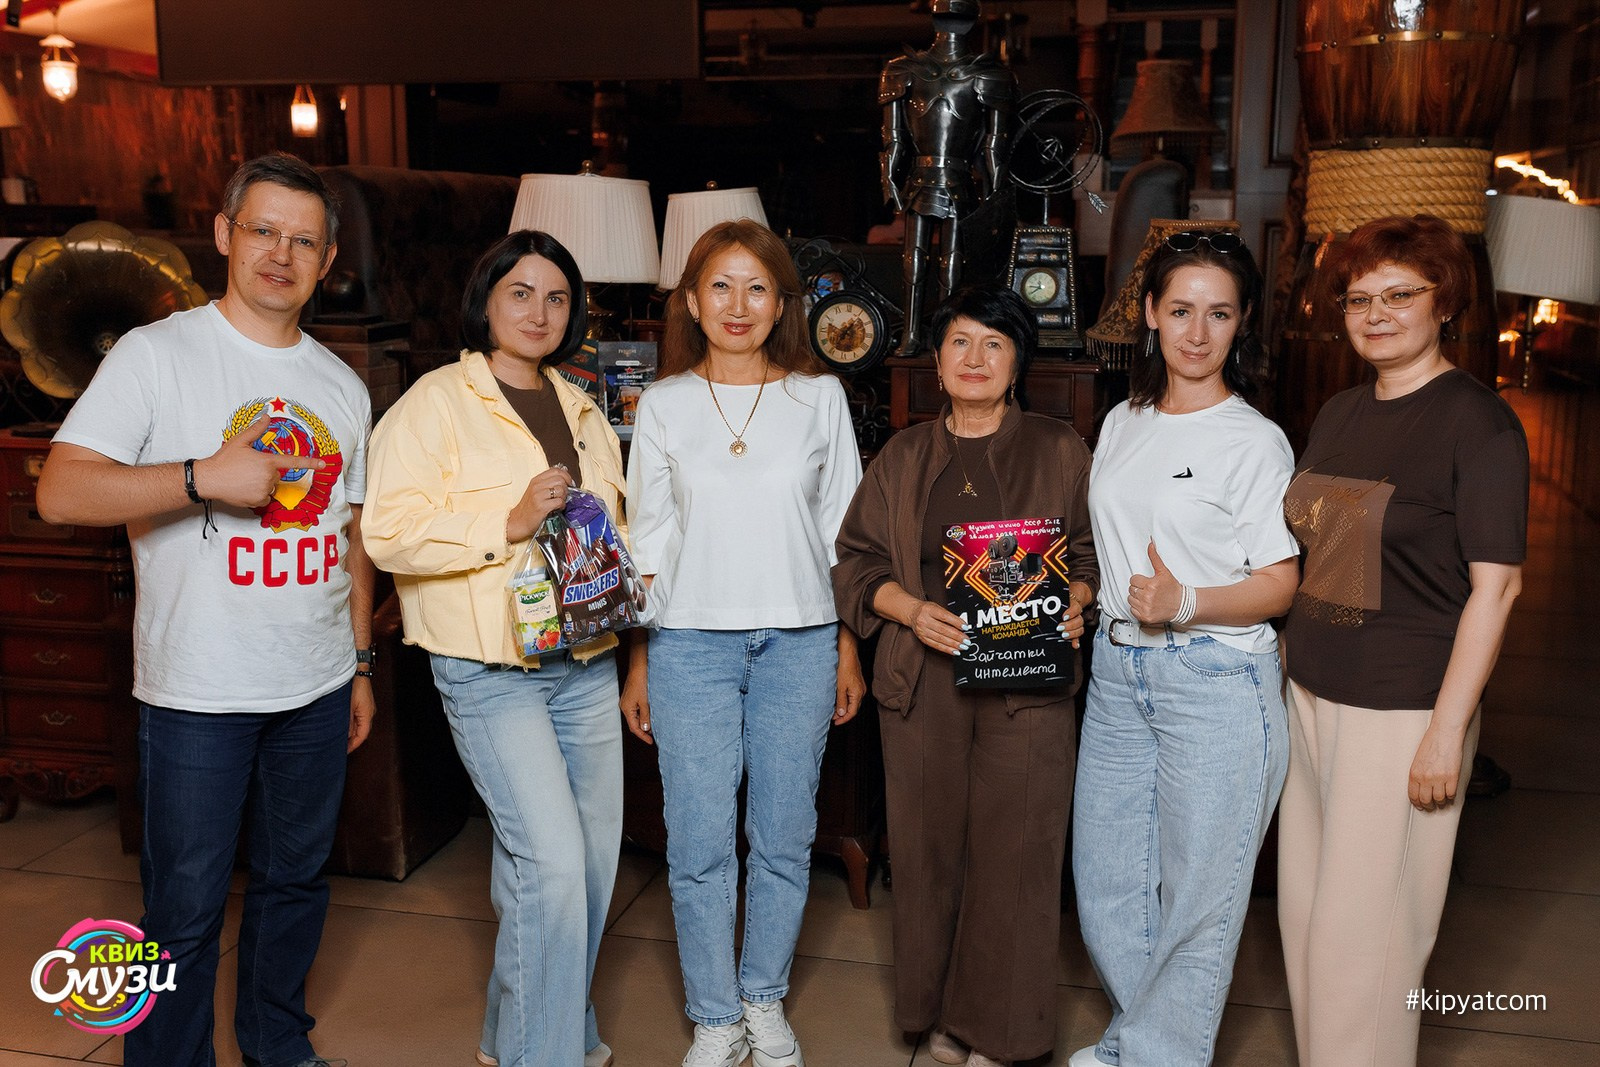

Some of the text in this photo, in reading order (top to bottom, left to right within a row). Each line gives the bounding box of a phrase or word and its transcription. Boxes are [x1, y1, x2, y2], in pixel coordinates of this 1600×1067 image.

[228, 533, 339, 588] СССР
[564, 567, 619, 604] SNICKERS
[587, 597, 608, 612] MINIS
[976, 596, 1062, 629] МЕСТО
[981, 618, 1040, 635] НАГРАЖДАЕТСЯ
[992, 628, 1031, 641] КОМАНДА
[963, 643, 1046, 663] Зайчатки
[974, 663, 1057, 679] интеллекта
